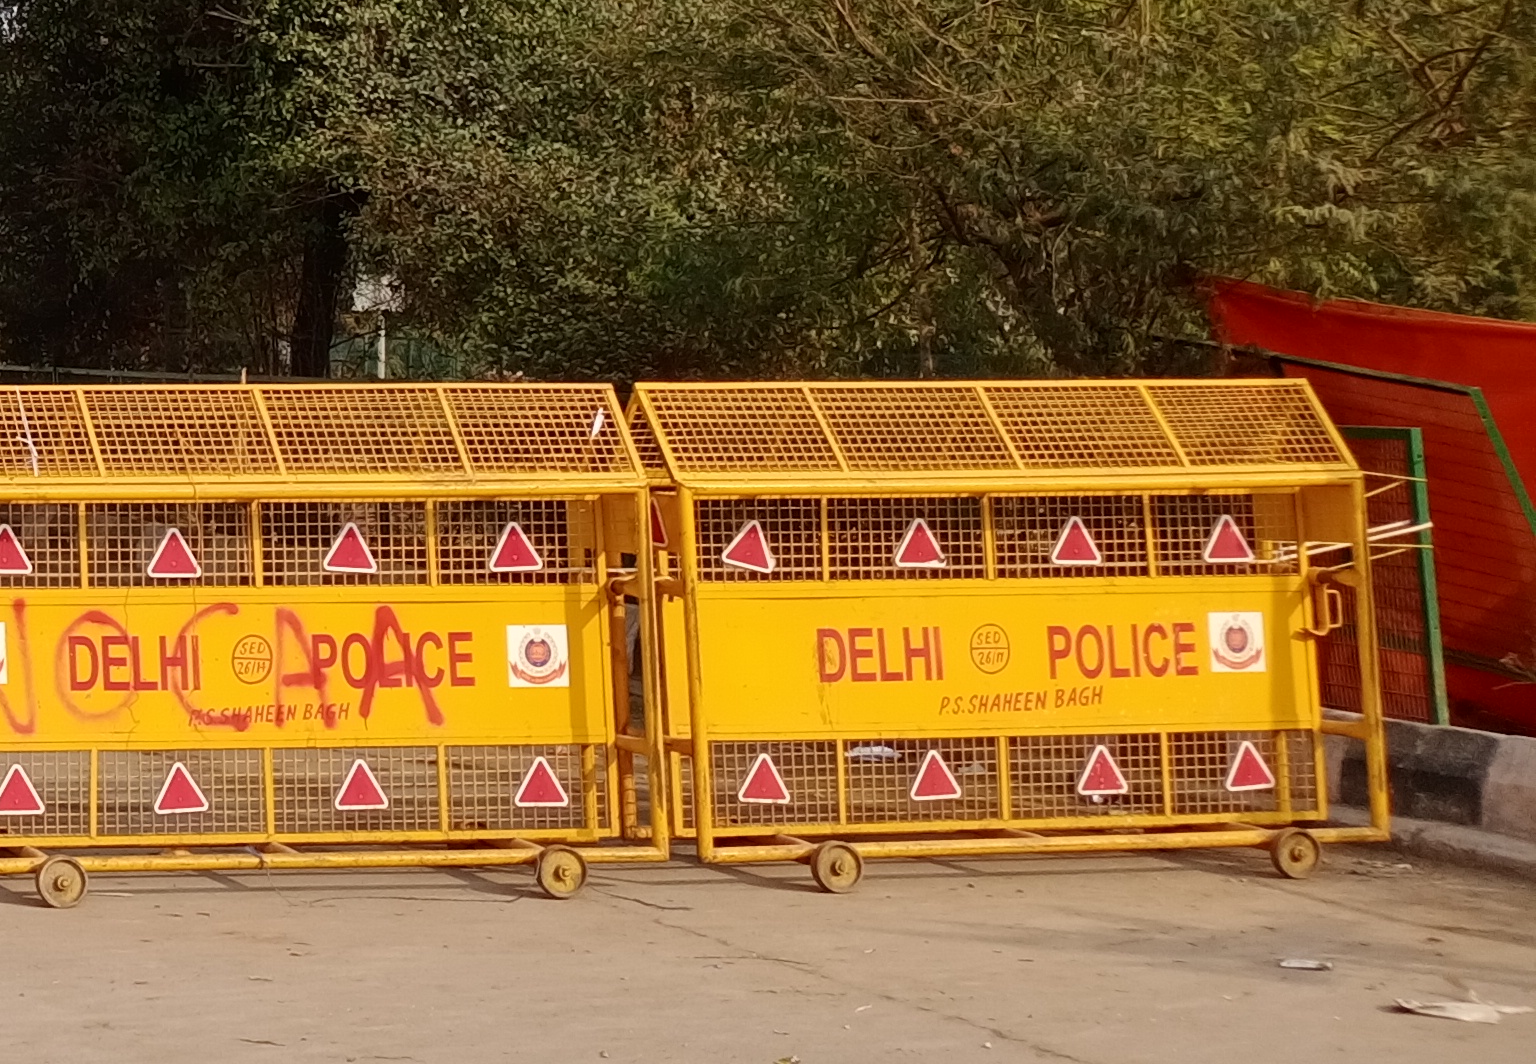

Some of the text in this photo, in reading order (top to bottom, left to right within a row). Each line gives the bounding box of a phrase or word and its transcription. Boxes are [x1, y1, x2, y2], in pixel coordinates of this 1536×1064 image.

[239, 641, 266, 656] SED
[975, 630, 1004, 645] SED
[68, 631, 476, 692] DELHI POLICE
[815, 621, 1199, 684] DELHI POLICE
[171, 602, 444, 732] CAA
[1054, 685, 1104, 708] BAGH
[303, 701, 351, 722] BAGH
